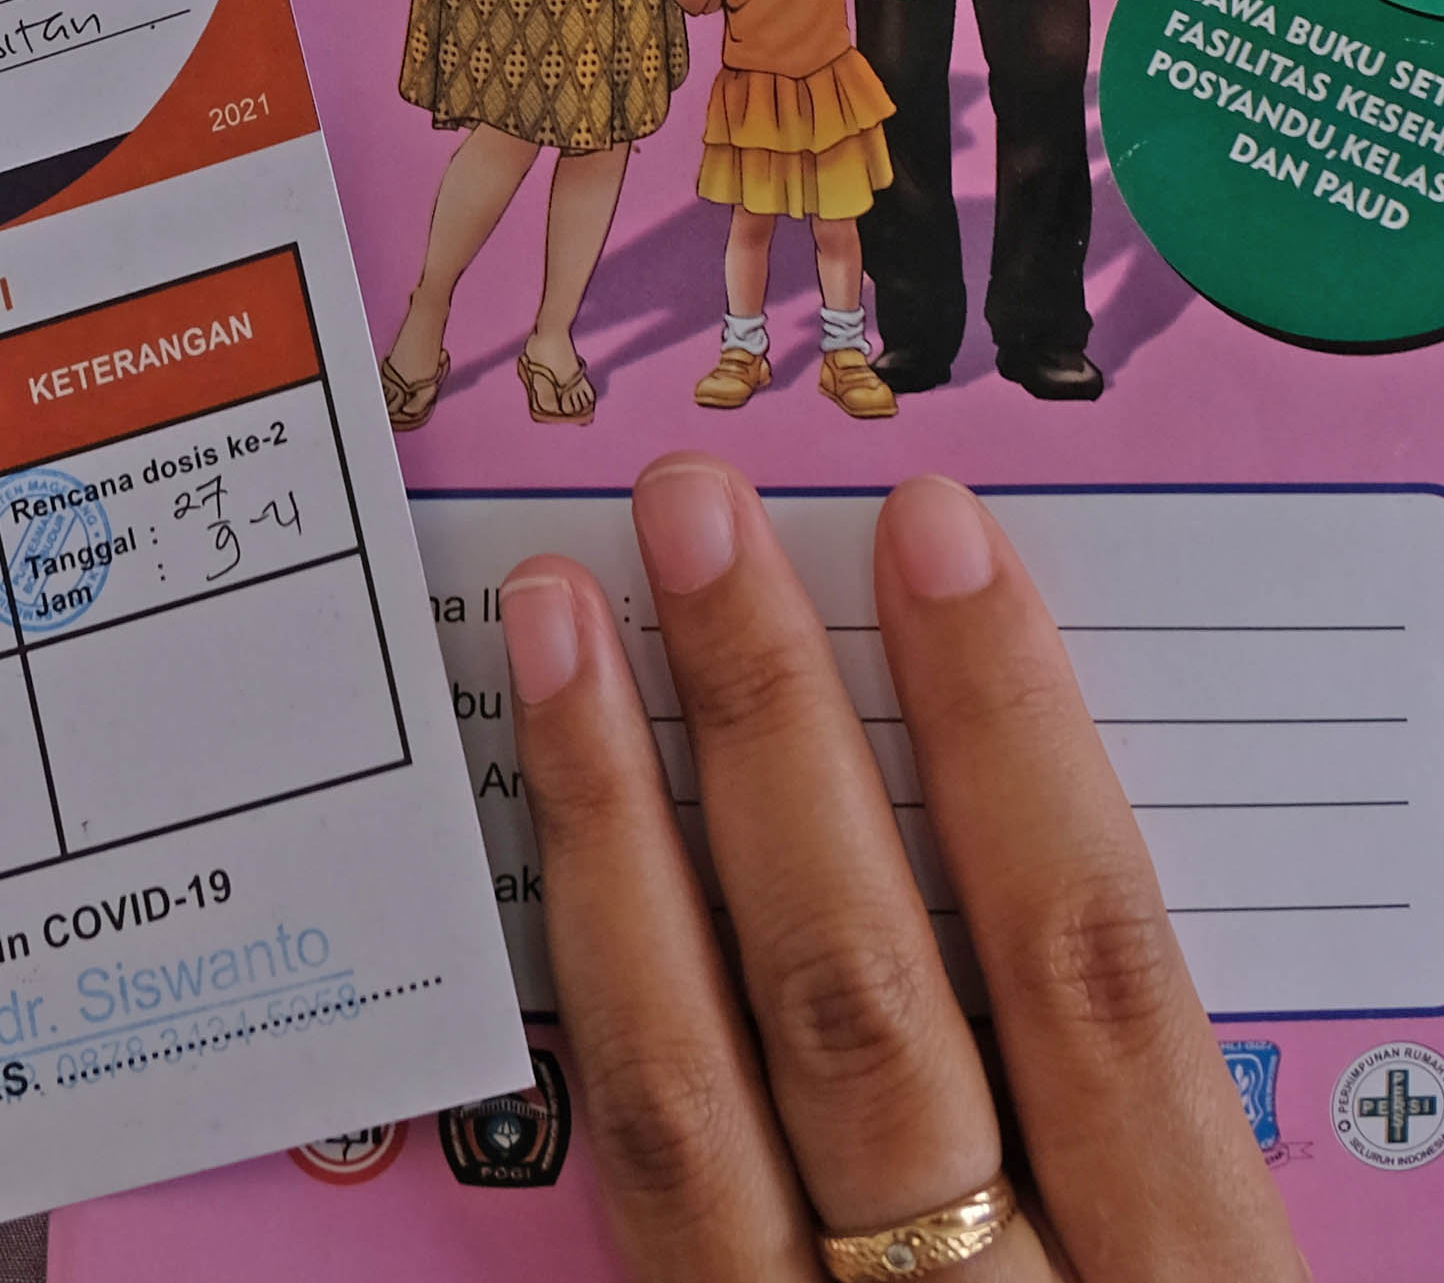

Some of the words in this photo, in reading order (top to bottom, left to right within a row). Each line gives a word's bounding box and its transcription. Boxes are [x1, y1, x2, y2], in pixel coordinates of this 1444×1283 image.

[1163, 10, 1331, 102] FASILITAS
[1285, 16, 1387, 77] BUKU
[209, 93, 269, 132] 2021
[1229, 134, 1309, 189] DAN
[1313, 170, 1410, 230] PAUD
[27, 311, 255, 406] KETERANGAN
[11, 473, 133, 523] Rencana
[143, 446, 218, 484] dosis
[227, 422, 288, 459] ke-2
[25, 527, 137, 580] Tanggal
[36, 585, 92, 618] Jam
[43, 867, 232, 948] COVID-19
[77, 924, 330, 1024] Siswanto
[1338, 1048, 1400, 1113] PERHIMPUNAN
